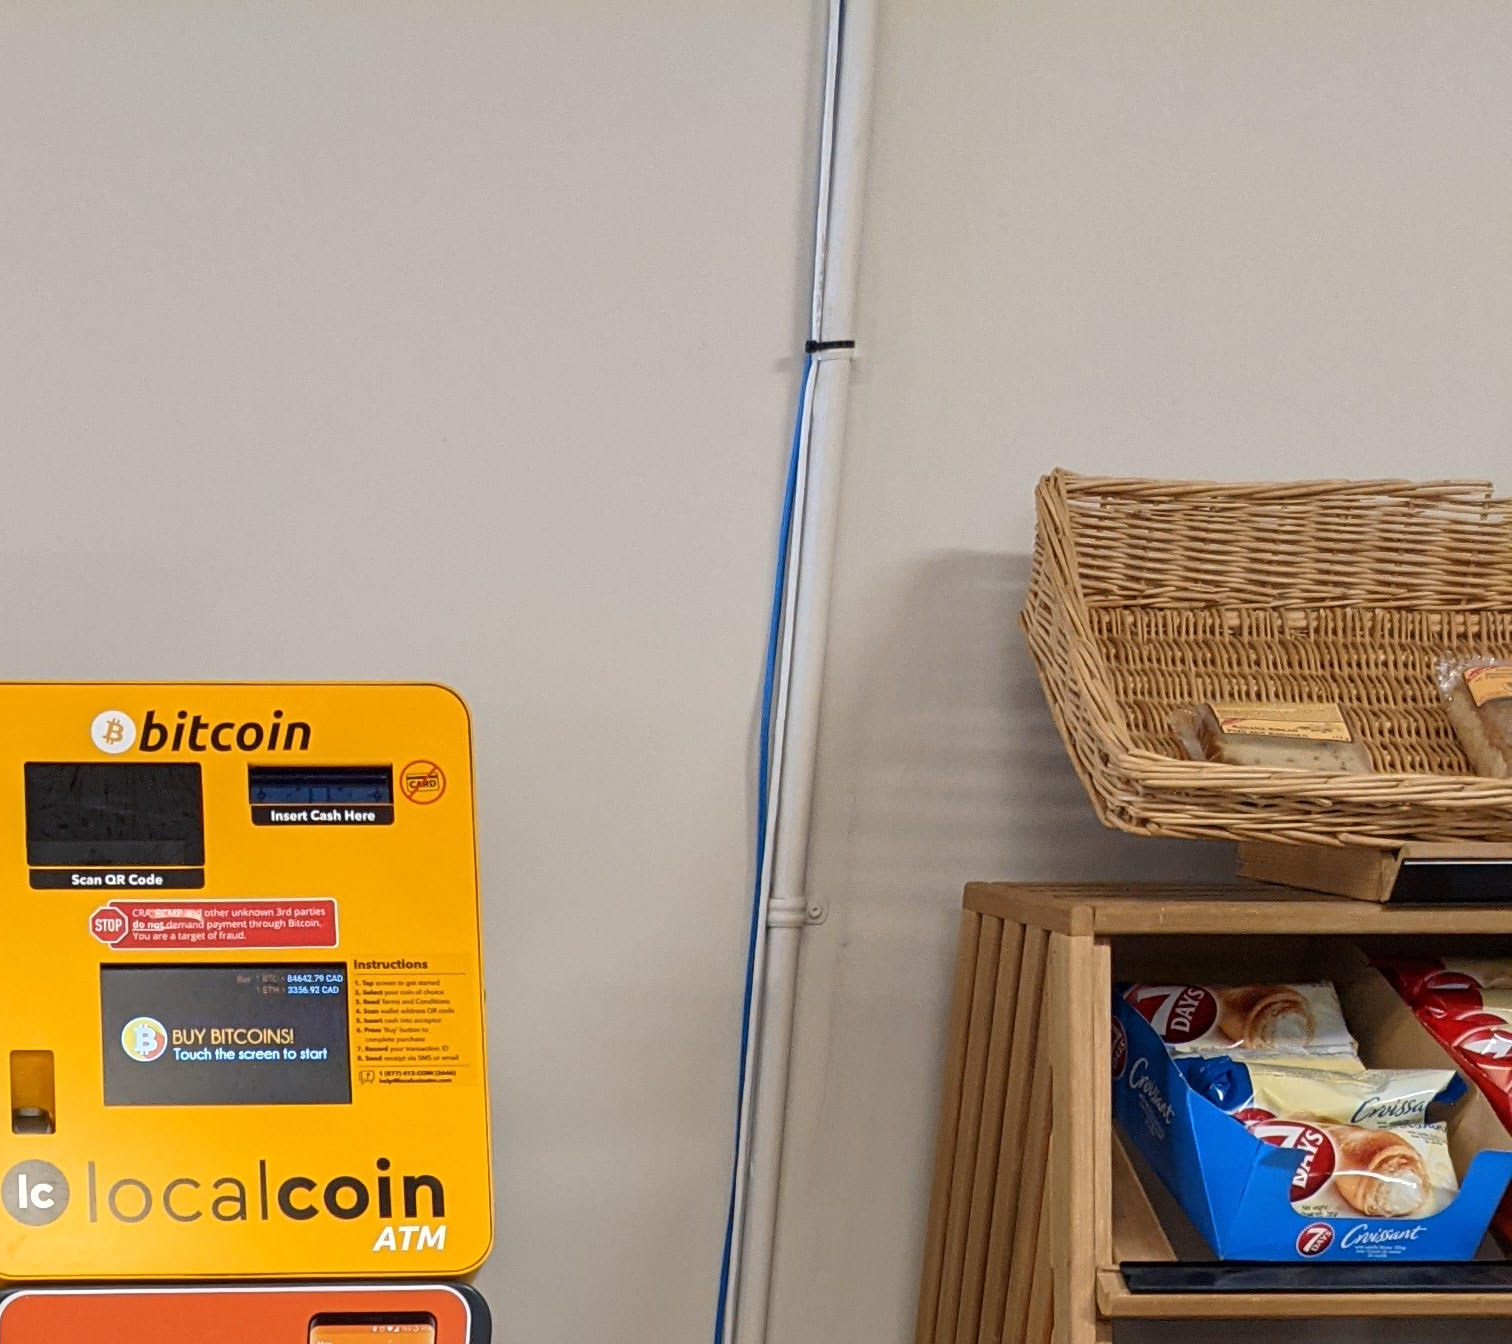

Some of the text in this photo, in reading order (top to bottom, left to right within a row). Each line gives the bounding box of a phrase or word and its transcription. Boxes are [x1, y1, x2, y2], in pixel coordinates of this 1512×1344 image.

[139, 709, 312, 753] bitcoin
[407, 778, 438, 789] CARD
[270, 809, 375, 823] Insert Cash Here
[71, 873, 163, 887] Scan QR Code
[204, 909, 229, 917] other
[232, 908, 274, 917] unknown
[276, 908, 292, 916] 3rd
[294, 908, 325, 917] parties
[95, 919, 122, 932] STOP
[132, 921, 145, 929] do
[148, 921, 164, 929] not
[166, 921, 204, 929] demand
[207, 921, 246, 930] payment
[248, 920, 286, 930] through
[178, 932, 205, 941] target
[207, 931, 218, 940] of
[219, 931, 246, 940] fraud.
[353, 959, 428, 969] Instructions
[1138, 985, 1205, 1036] 7 DAYS
[172, 1028, 294, 1045] BUY BITCOINS!
[173, 1048, 328, 1061] Touch the screen to start
[18, 1157, 445, 1223] lc localcoin
[372, 1225, 447, 1252] ATM
[1305, 1227, 1327, 1252] 7
[1312, 1231, 1332, 1251] DAYS
[1341, 1223, 1427, 1249] Croissant
